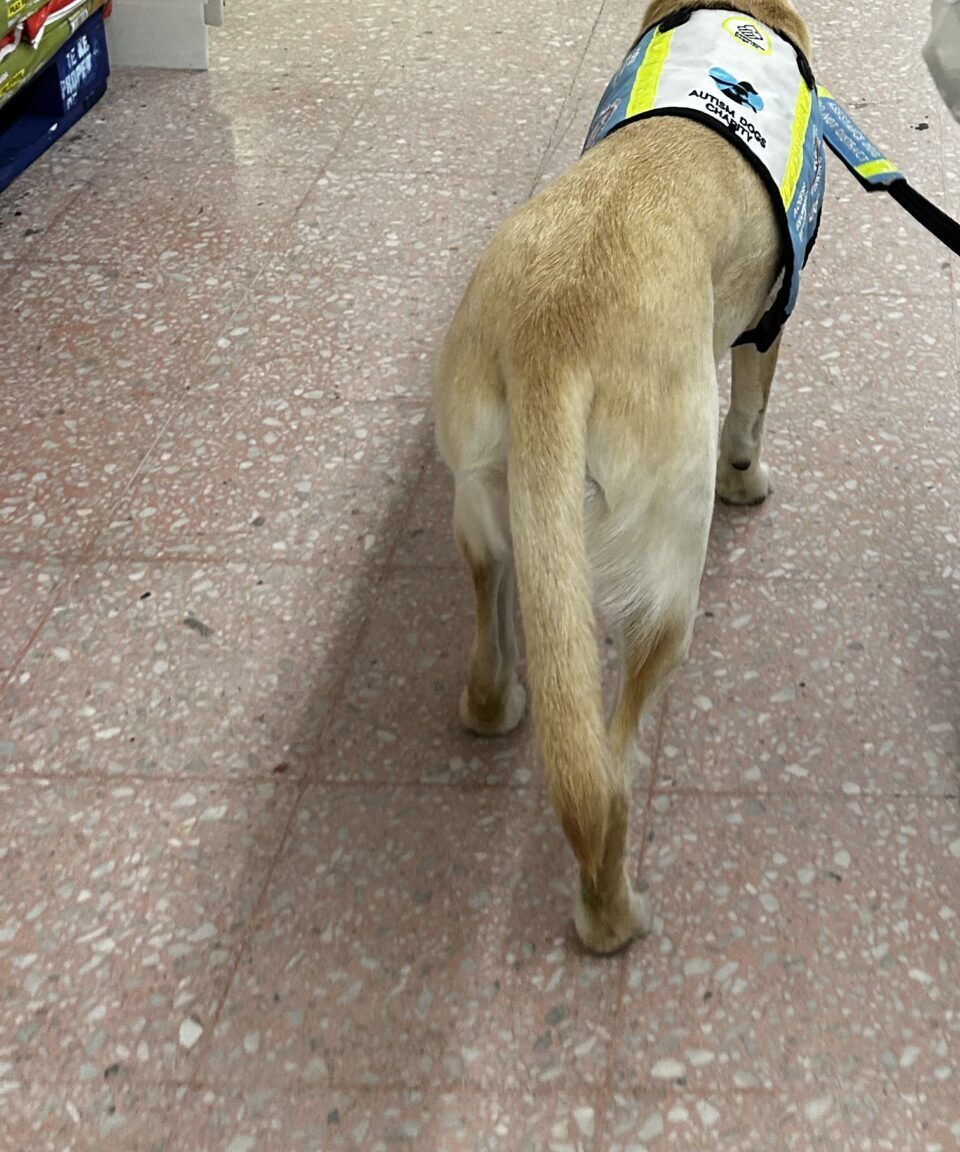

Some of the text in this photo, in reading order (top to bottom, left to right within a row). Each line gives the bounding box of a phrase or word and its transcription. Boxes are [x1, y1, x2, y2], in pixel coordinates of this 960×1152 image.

[688, 89, 767, 149] AUTISM DOGS
[705, 103, 753, 142] CHARITY
